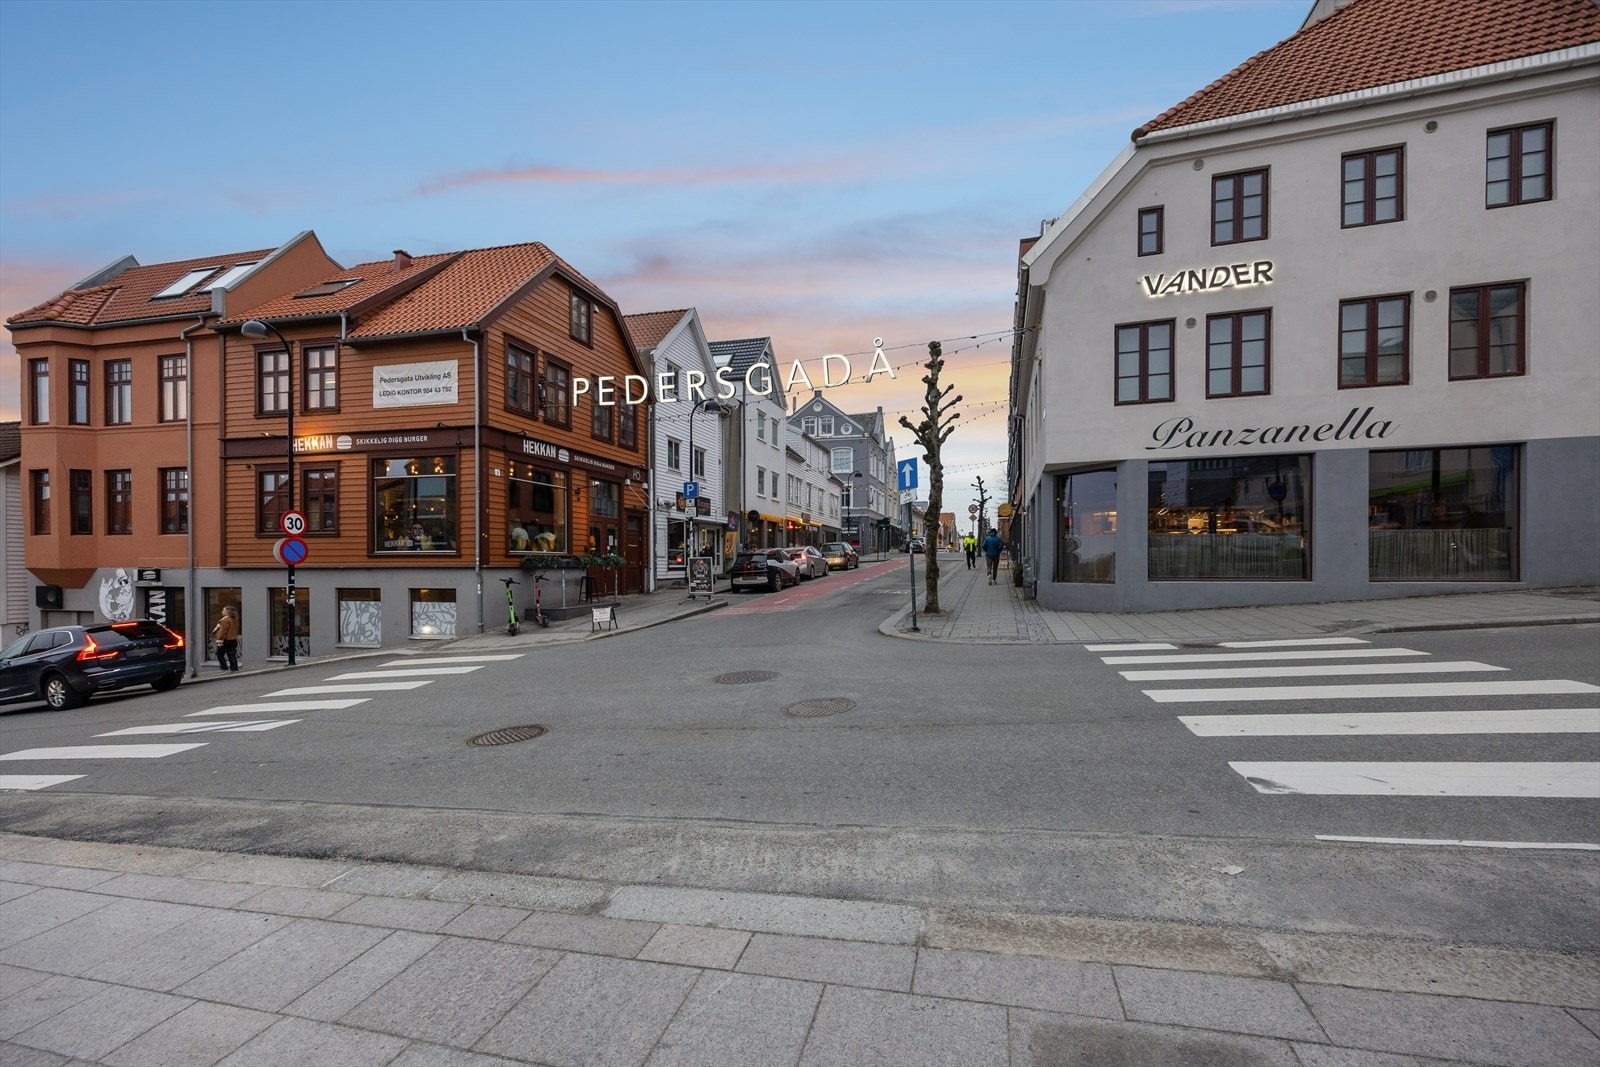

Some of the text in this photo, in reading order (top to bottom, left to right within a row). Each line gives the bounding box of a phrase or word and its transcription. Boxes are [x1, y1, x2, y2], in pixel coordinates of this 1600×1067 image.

[1144, 261, 1273, 295] VANDER
[379, 371, 451, 384] Pedersgata Utvikling AS
[573, 337, 897, 406] PEDERSGADÅ
[397, 388, 422, 396] KONTOR
[1145, 407, 1400, 450] Panzanella
[293, 435, 333, 452] HEKKAN
[356, 437, 387, 445] SKIKKELIG
[403, 435, 428, 443] BURGER
[523, 439, 556, 458] HEKKAN
[687, 484, 694, 496] P
[287, 517, 303, 530] 30
